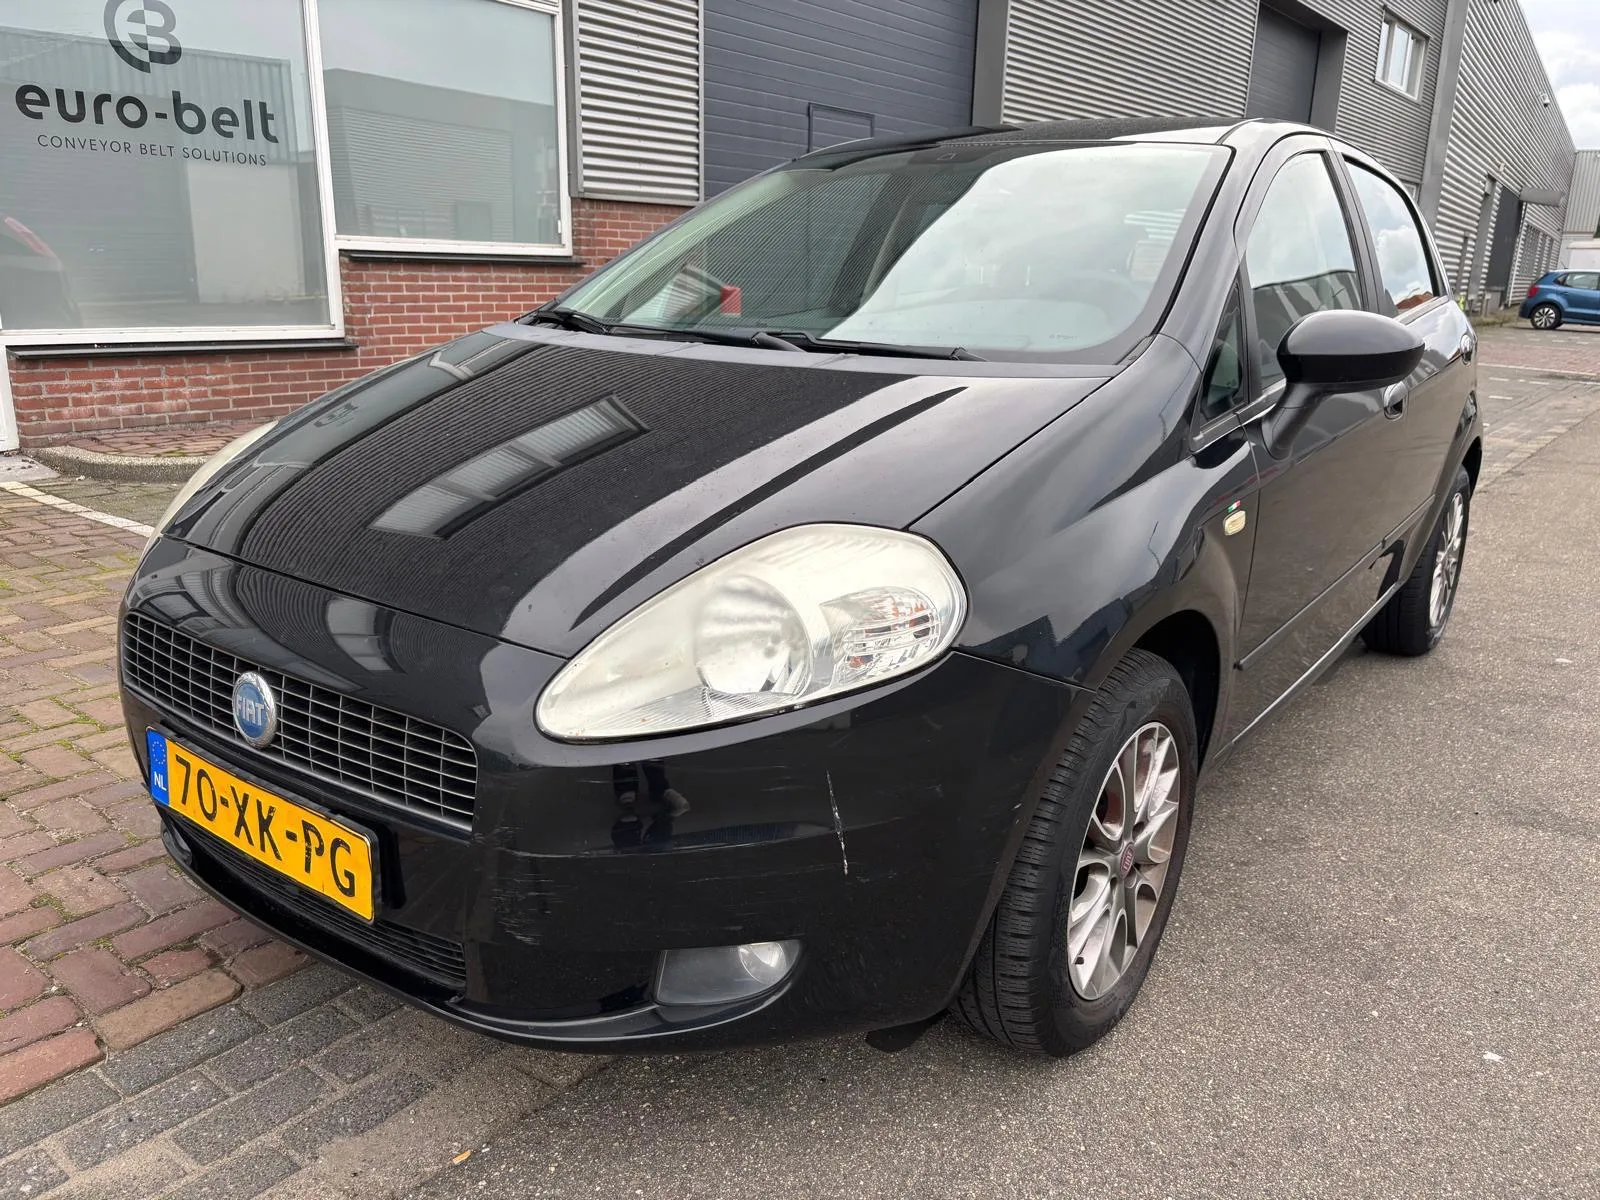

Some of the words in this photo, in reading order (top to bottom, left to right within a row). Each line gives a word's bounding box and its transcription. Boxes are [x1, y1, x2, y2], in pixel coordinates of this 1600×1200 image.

[15, 84, 279, 144] euro-belt
[37, 134, 132, 154] CONVEYOR
[139, 143, 174, 157] BELT
[182, 147, 267, 167] SOLUTIONS
[235, 694, 265, 726] FIAT
[153, 770, 167, 791] NL
[175, 754, 356, 898] 70-XK-PG
